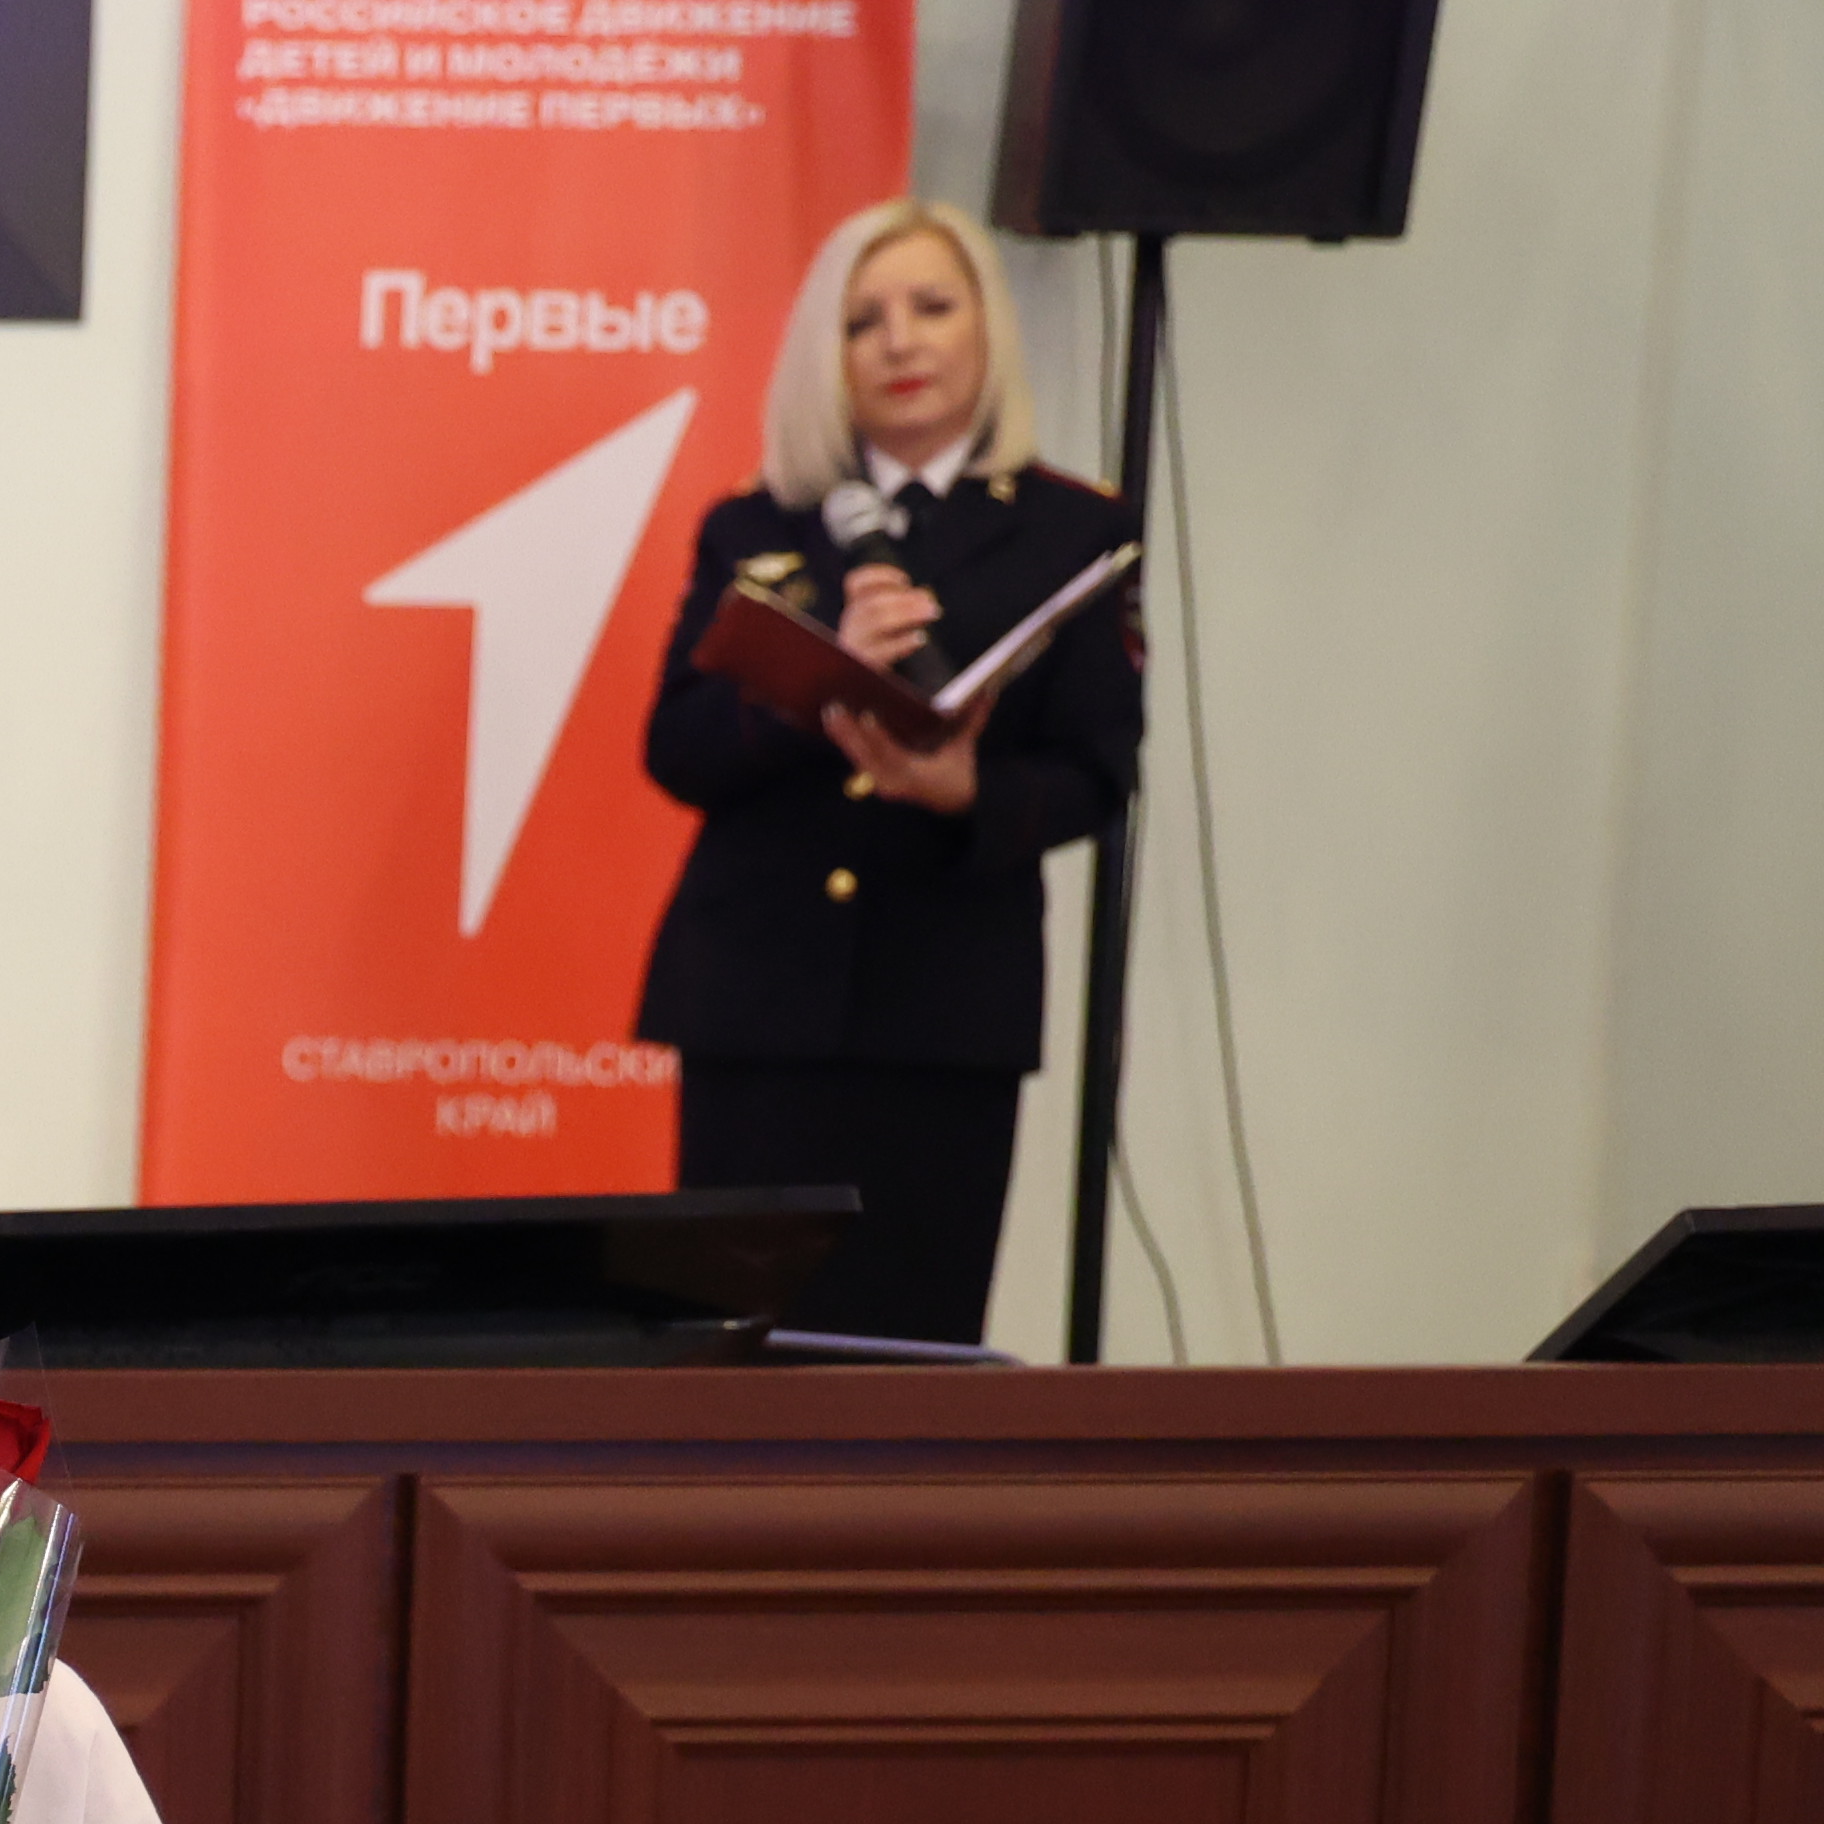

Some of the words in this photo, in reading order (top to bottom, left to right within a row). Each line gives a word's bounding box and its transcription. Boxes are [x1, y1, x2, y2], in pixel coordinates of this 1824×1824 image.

[405, 41, 442, 80] И
[361, 269, 707, 373] Первые
[282, 1036, 680, 1087] СТАВРОПОЛЬСКИ
[436, 1089, 556, 1137] КРАЙ
